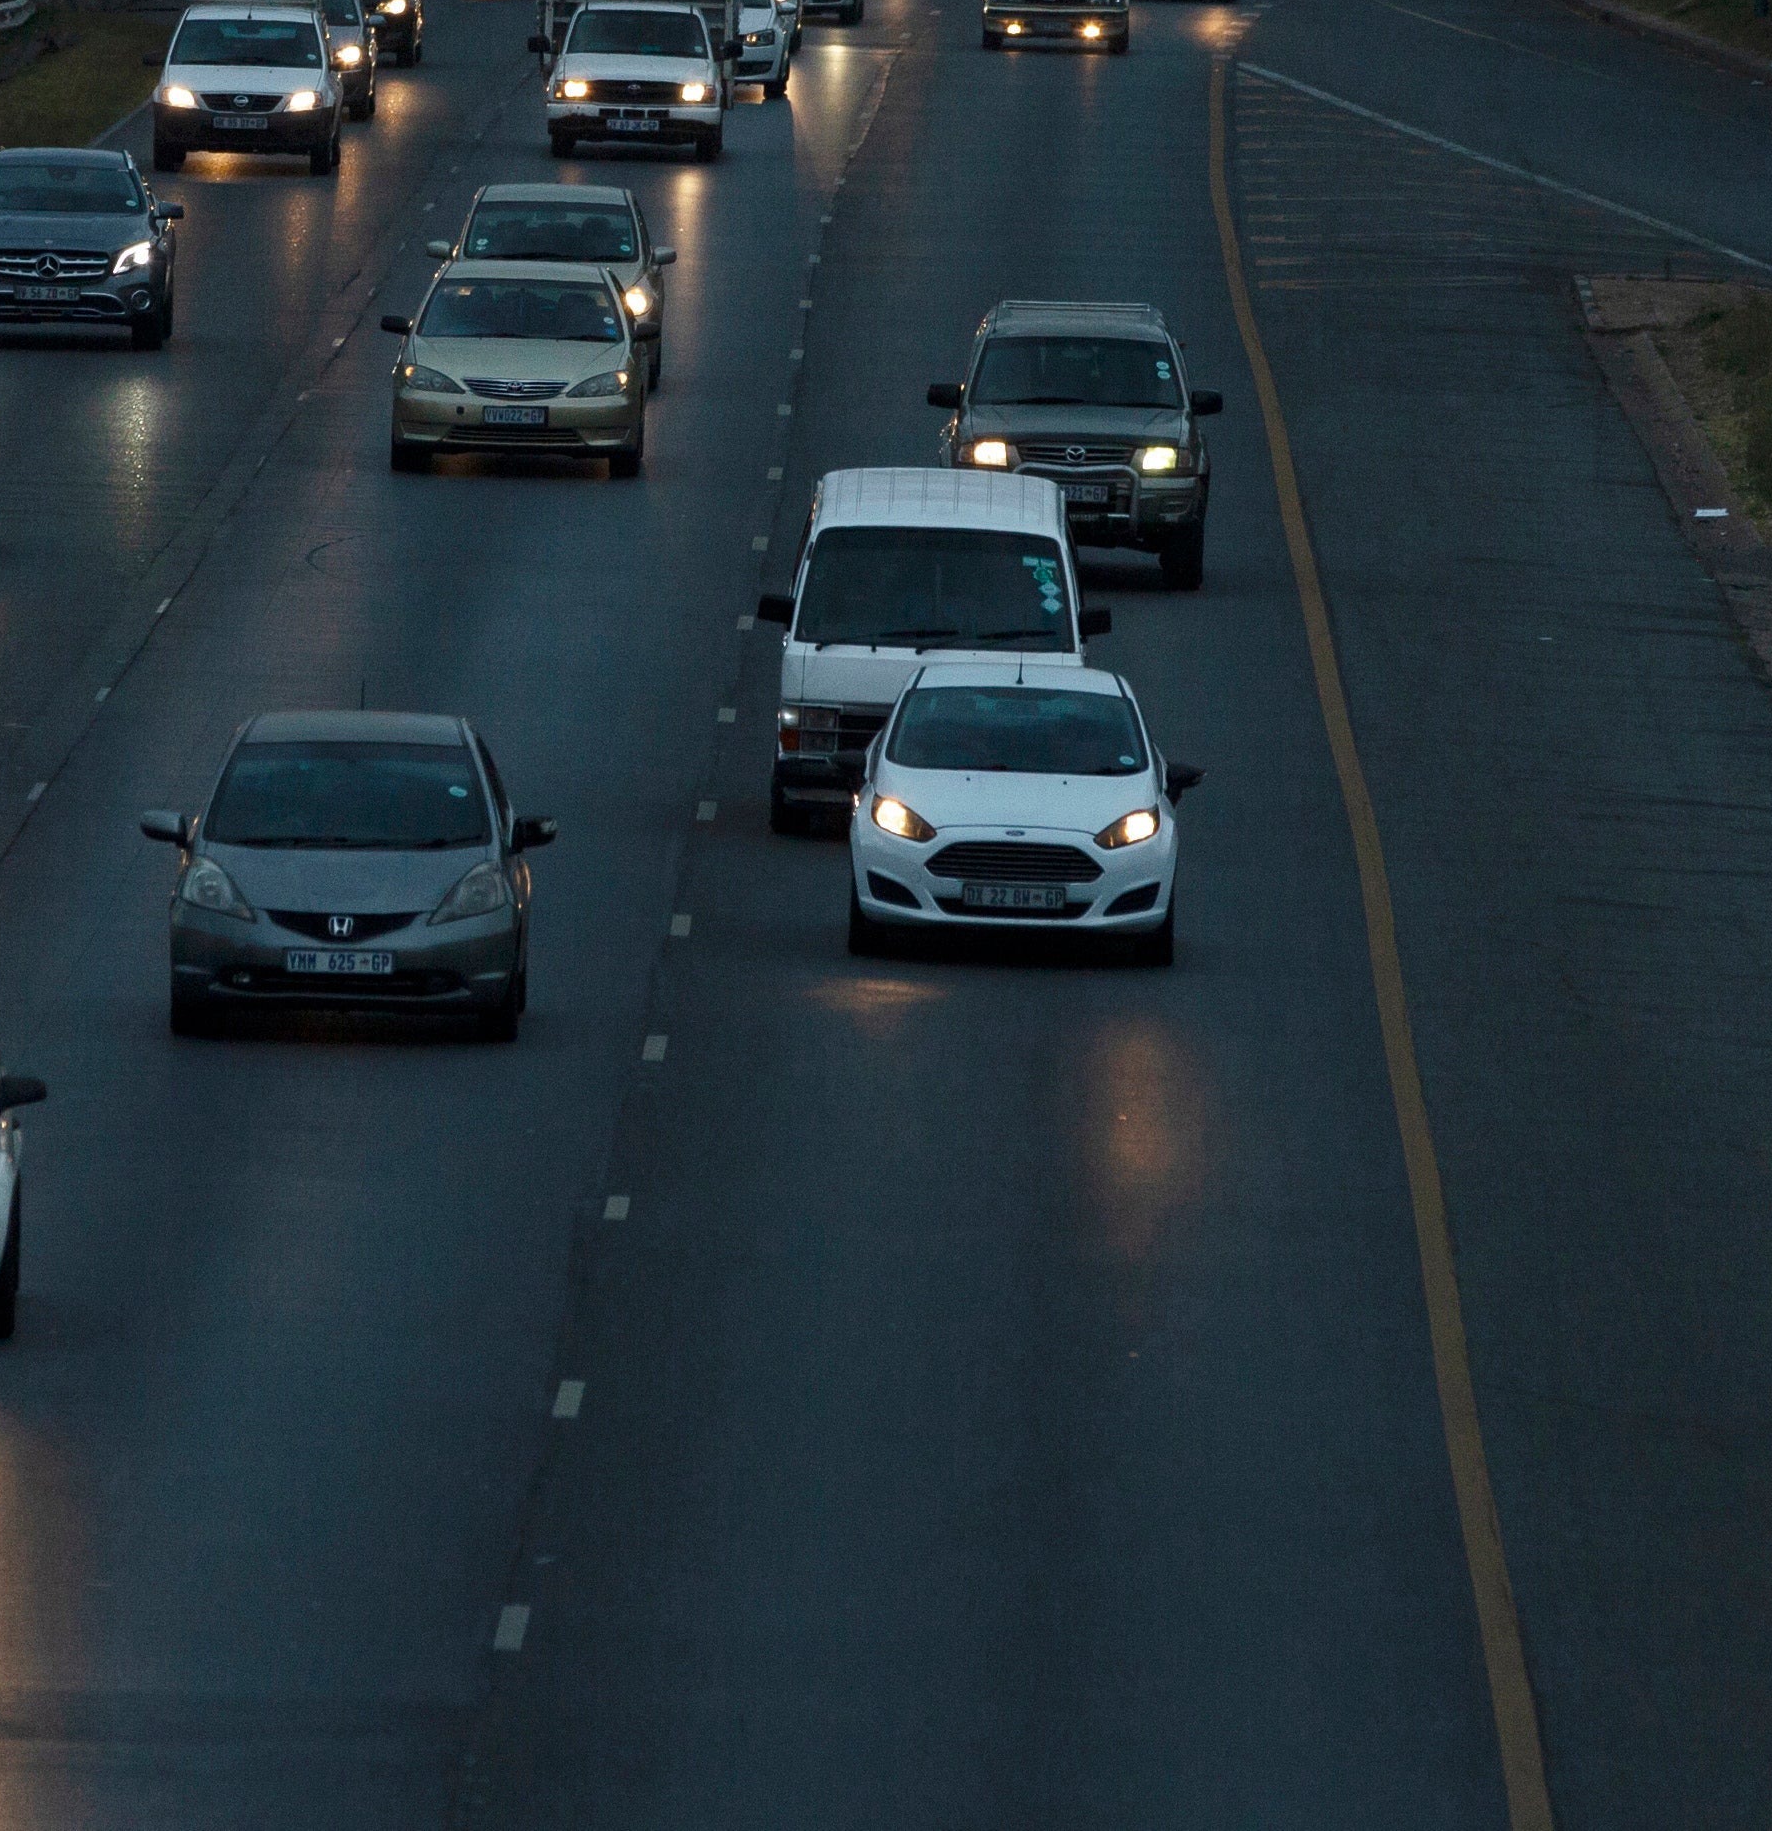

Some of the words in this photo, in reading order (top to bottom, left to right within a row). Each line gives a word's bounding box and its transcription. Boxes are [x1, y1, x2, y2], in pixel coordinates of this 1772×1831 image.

[530, 408, 543, 422] GP
[1093, 487, 1108, 501] GP
[966, 887, 983, 905] DX
[990, 888, 1006, 905] 22
[1045, 890, 1064, 907] GP
[288, 952, 317, 970] YMM
[328, 953, 355, 971] 625
[371, 953, 390, 972] GP
